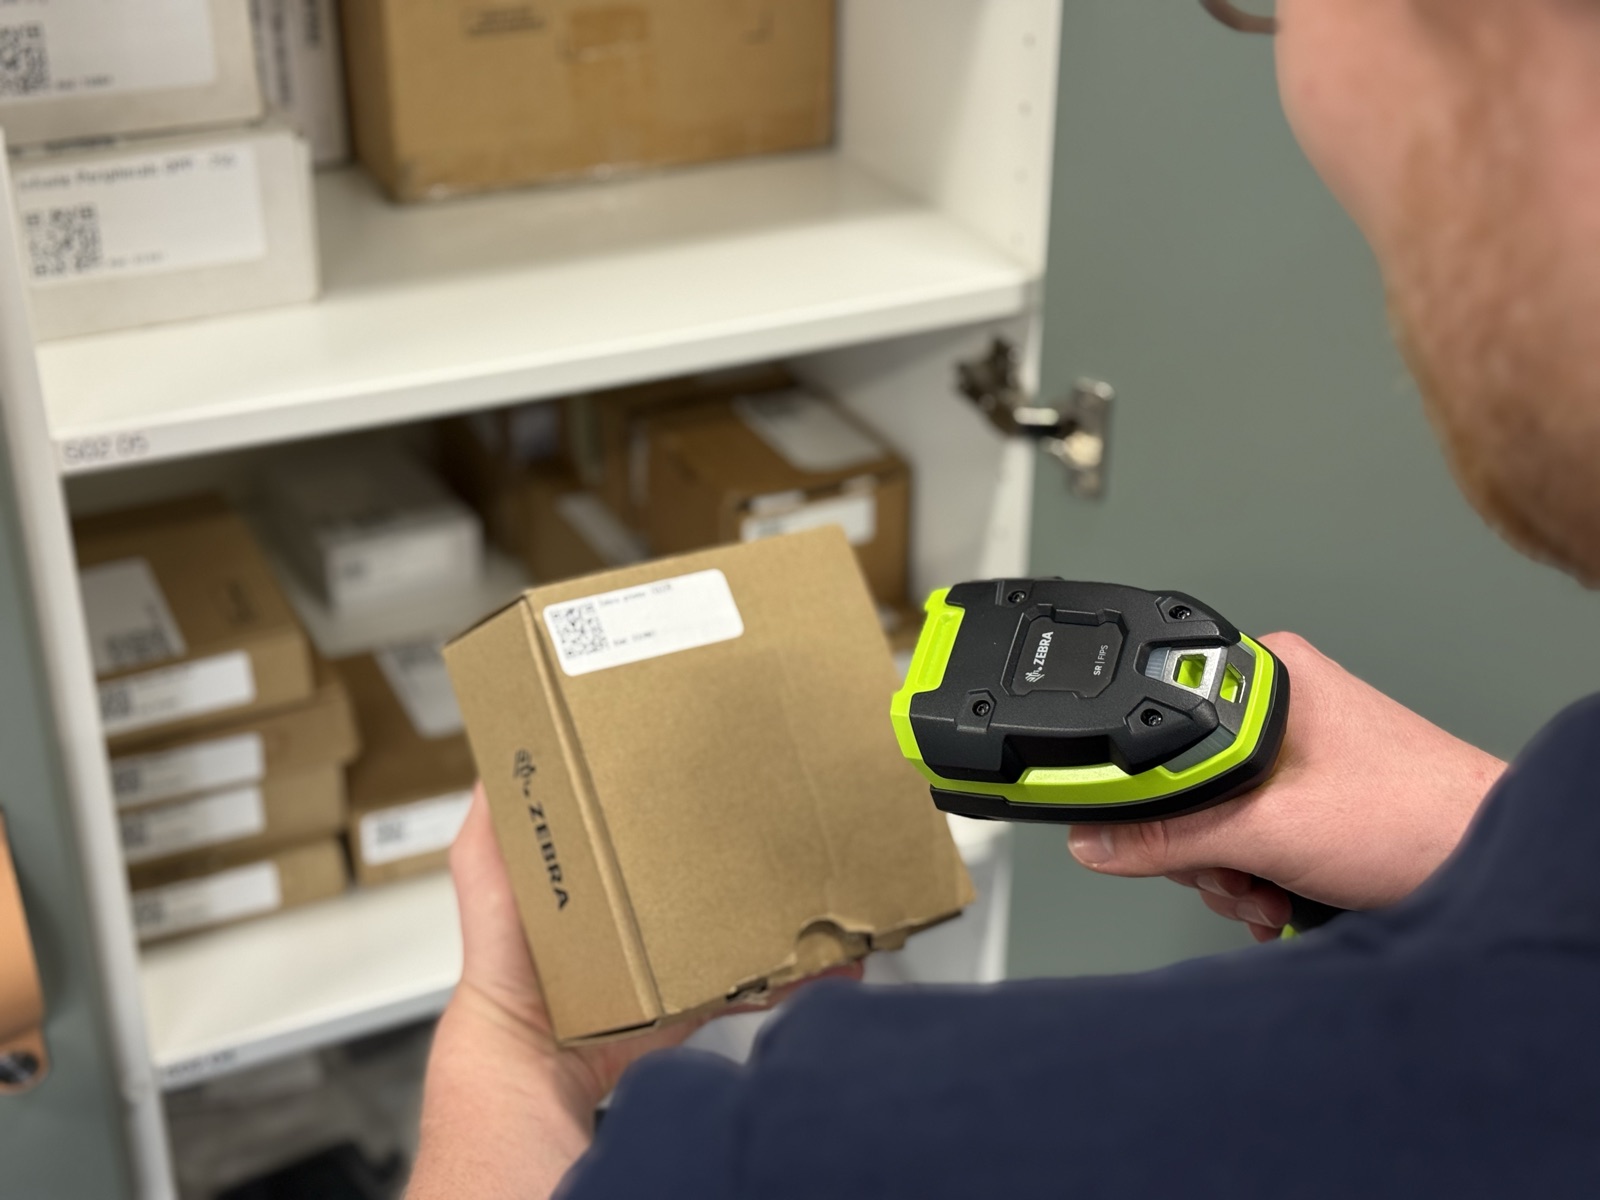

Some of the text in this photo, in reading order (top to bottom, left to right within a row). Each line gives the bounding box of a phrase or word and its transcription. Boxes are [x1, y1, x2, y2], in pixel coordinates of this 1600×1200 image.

[1033, 631, 1054, 666] ZEBRA
[1097, 644, 1109, 661] FIPS
[1093, 664, 1103, 676] SR
[529, 800, 569, 911] ZEBRA
